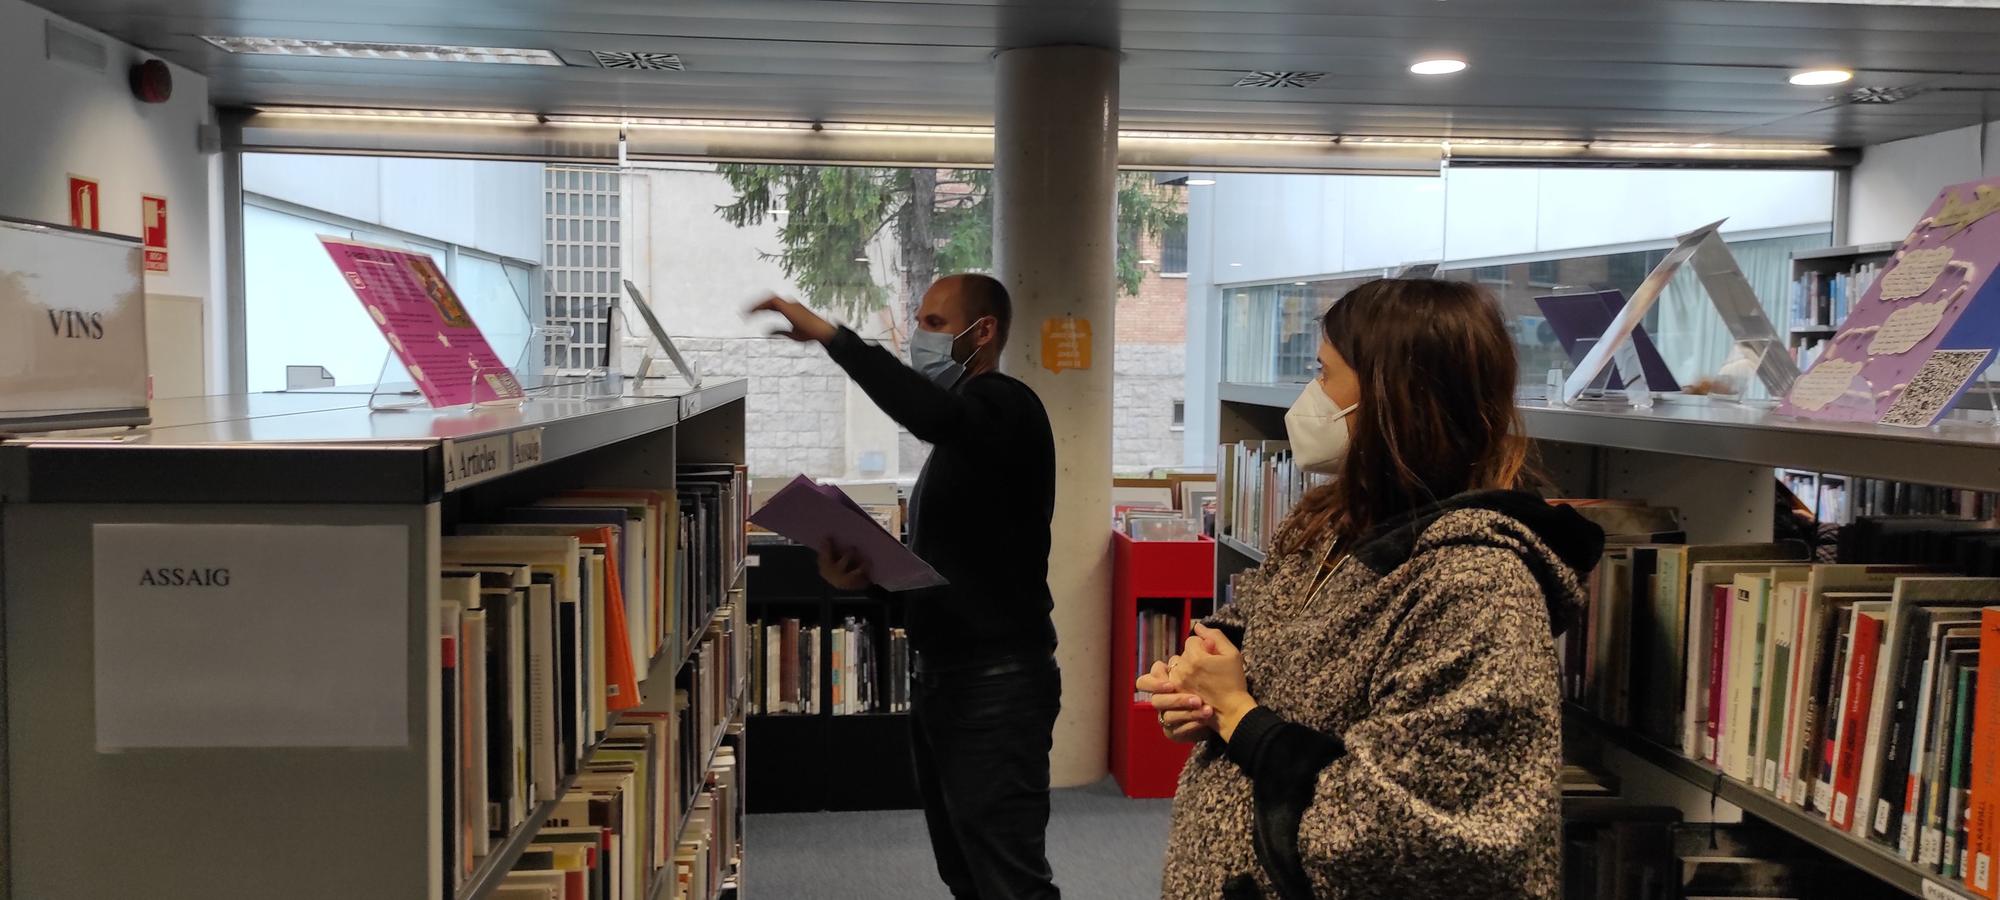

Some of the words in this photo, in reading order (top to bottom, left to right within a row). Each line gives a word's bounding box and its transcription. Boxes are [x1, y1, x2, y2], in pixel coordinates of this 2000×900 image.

[48, 308, 104, 340] VINS
[446, 451, 455, 482] A
[459, 443, 497, 480] Articles
[139, 568, 231, 587] ASSAIG
